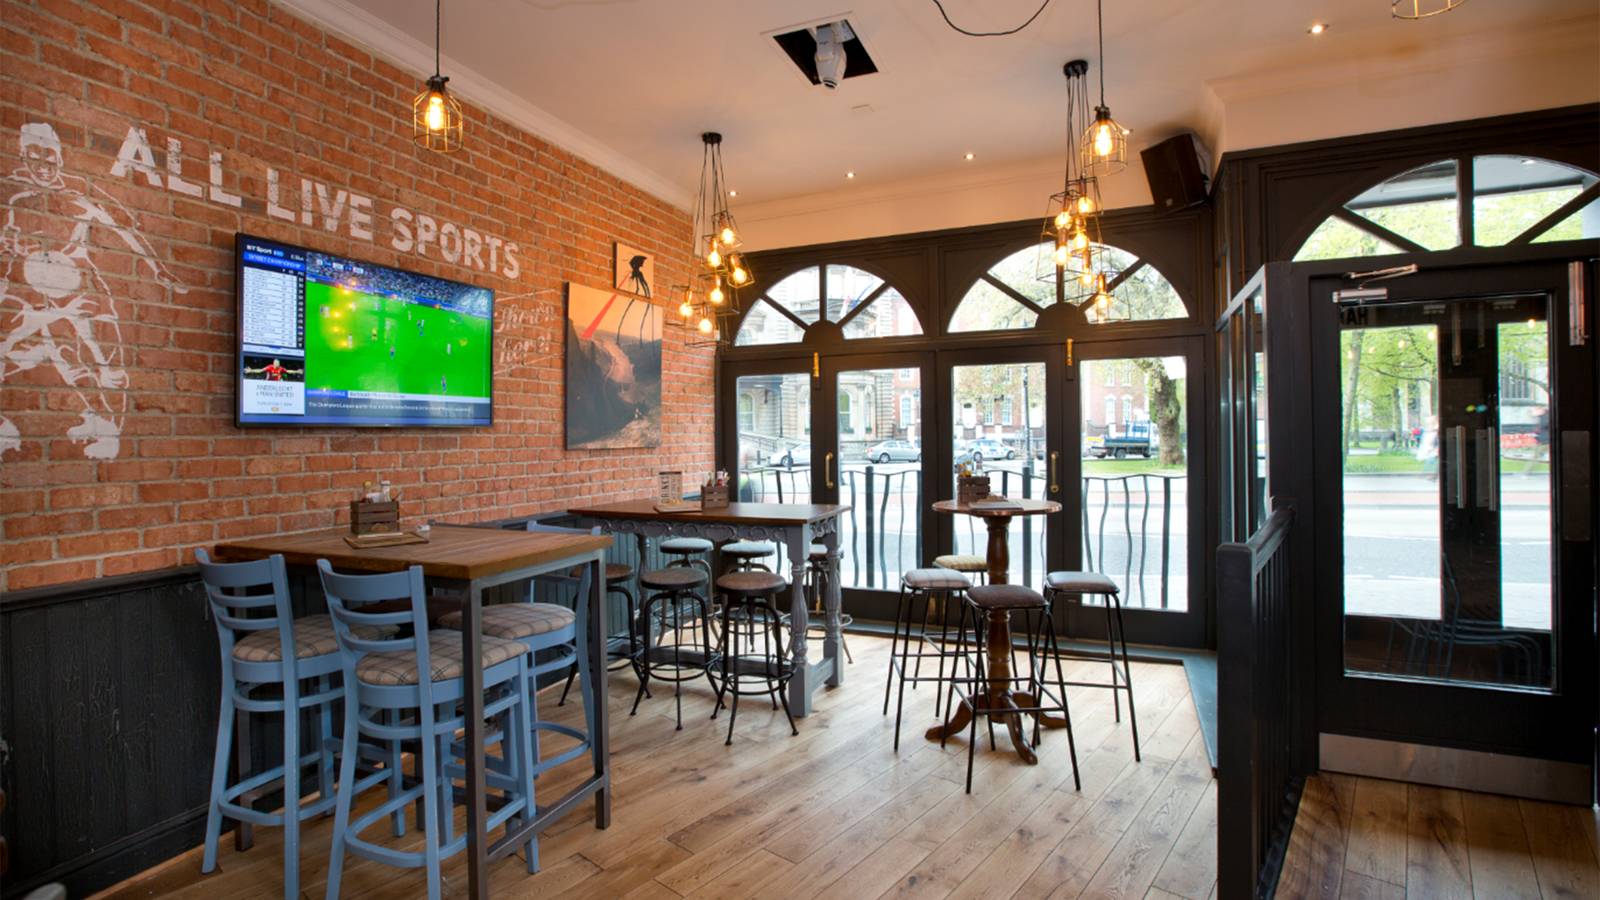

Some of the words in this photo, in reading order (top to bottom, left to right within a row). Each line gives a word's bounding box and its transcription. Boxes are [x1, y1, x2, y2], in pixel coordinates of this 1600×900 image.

[110, 127, 242, 207] ALL
[267, 168, 373, 241] LIVE
[391, 207, 520, 279] SPORTS
